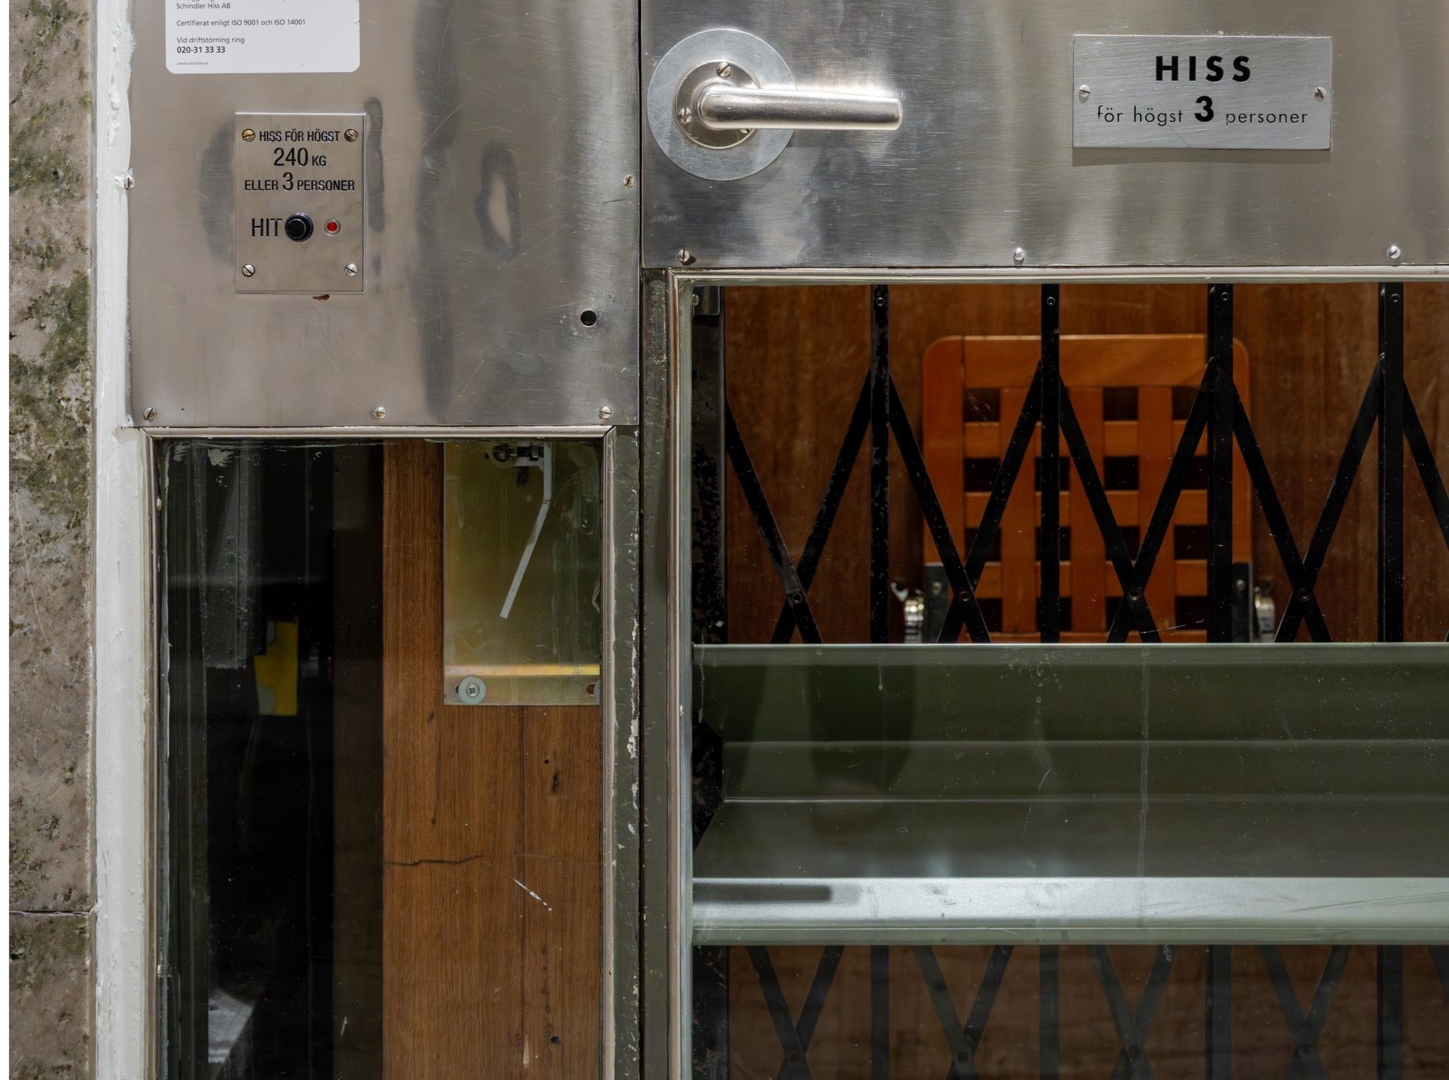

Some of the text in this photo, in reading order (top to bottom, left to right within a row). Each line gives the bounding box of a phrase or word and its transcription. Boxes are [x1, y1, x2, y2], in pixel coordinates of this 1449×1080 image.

[177, 46, 226, 54] 020-31 33 33
[1155, 55, 1251, 82] HISS
[1097, 95, 1308, 127] för högst 3 personer
[259, 128, 340, 142] HISS FÖR HÖGST
[273, 147, 327, 166] 240 KG
[244, 172, 355, 191] ELLER 3 PERSONER
[251, 218, 282, 237] HIT
